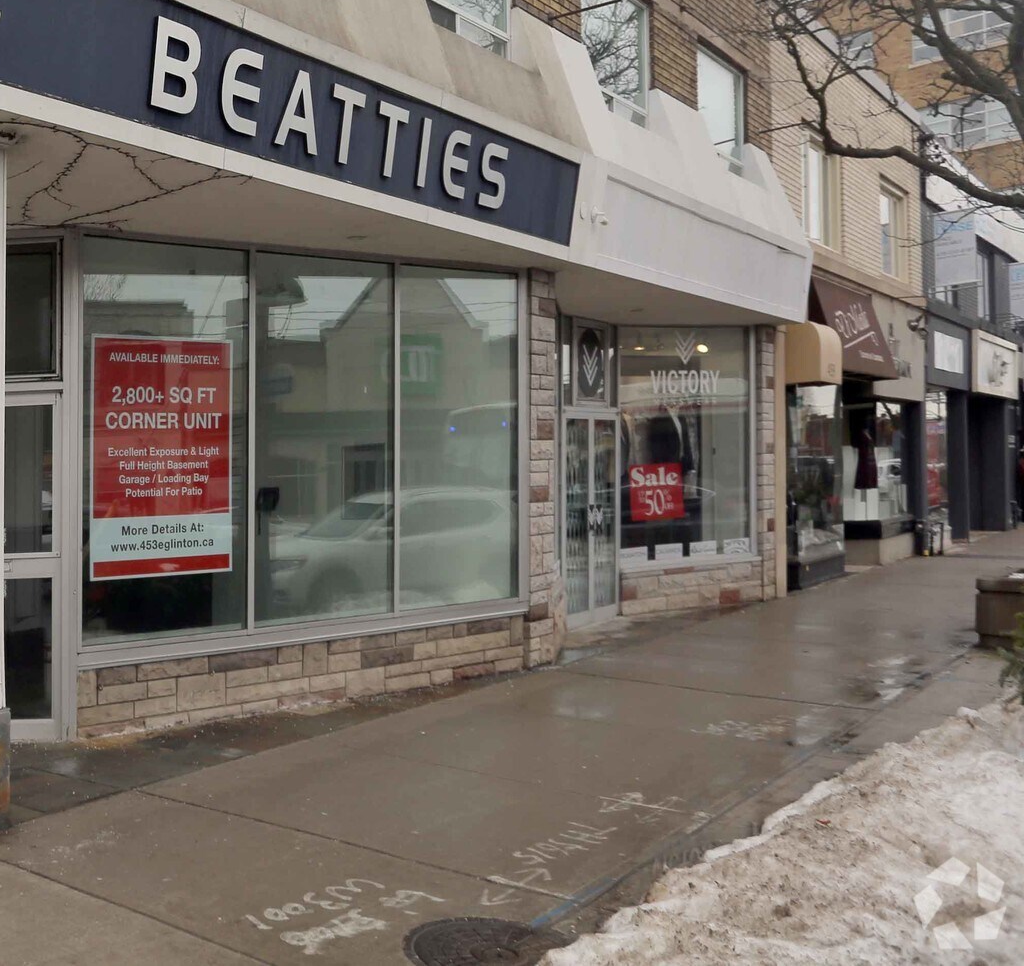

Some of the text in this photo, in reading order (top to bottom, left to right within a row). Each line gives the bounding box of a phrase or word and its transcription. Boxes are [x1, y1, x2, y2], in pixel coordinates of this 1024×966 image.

[150, 15, 510, 210] BEATTIES
[109, 352, 220, 365] AVAILABLE IMMEDIATELY:
[650, 370, 720, 395] VICTORY
[111, 386, 217, 406] 2,800+ SQ FT
[105, 412, 223, 430] CORNER UNIT
[108, 446, 219, 458] Excellent Exposure & Light
[119, 460, 209, 472] Full Height Basement
[119, 474, 150, 486] Garage
[158, 473, 191, 485] Loading
[193, 473, 209, 484] Bay
[630, 466, 678, 488] Sale
[125, 486, 203, 498] Potential For Patio
[121, 522, 204, 536] More Details At:
[111, 538, 214, 552] www.453eglinton.ca
